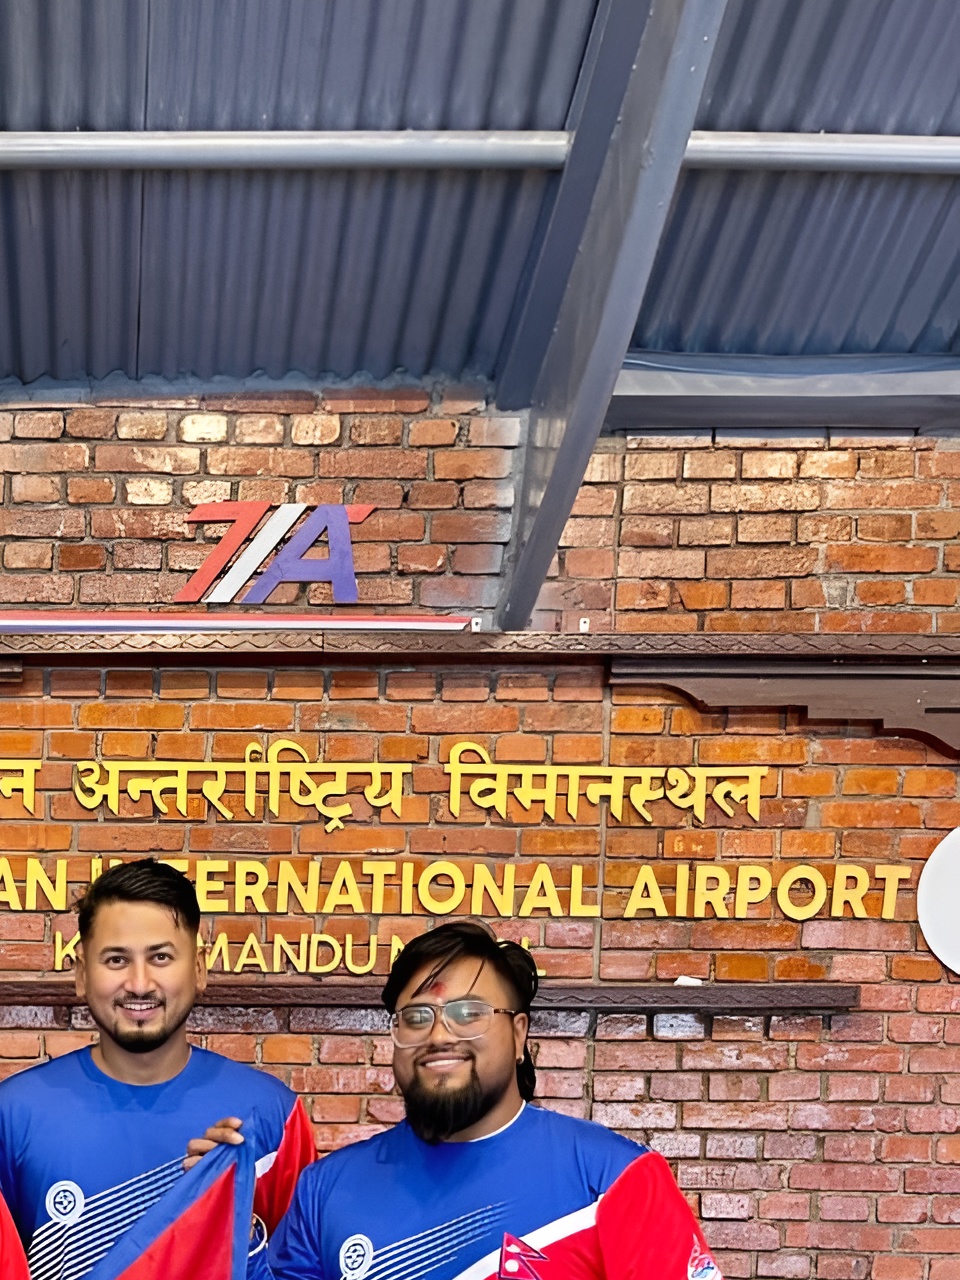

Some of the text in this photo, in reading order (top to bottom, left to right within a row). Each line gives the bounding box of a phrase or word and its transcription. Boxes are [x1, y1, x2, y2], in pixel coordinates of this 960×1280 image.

[444, 741, 769, 822] विमानस्थल
[92, 857, 601, 918] ERNATIONAL
[624, 864, 912, 921] AIRPORT
[54, 931, 378, 975] KMANDU
